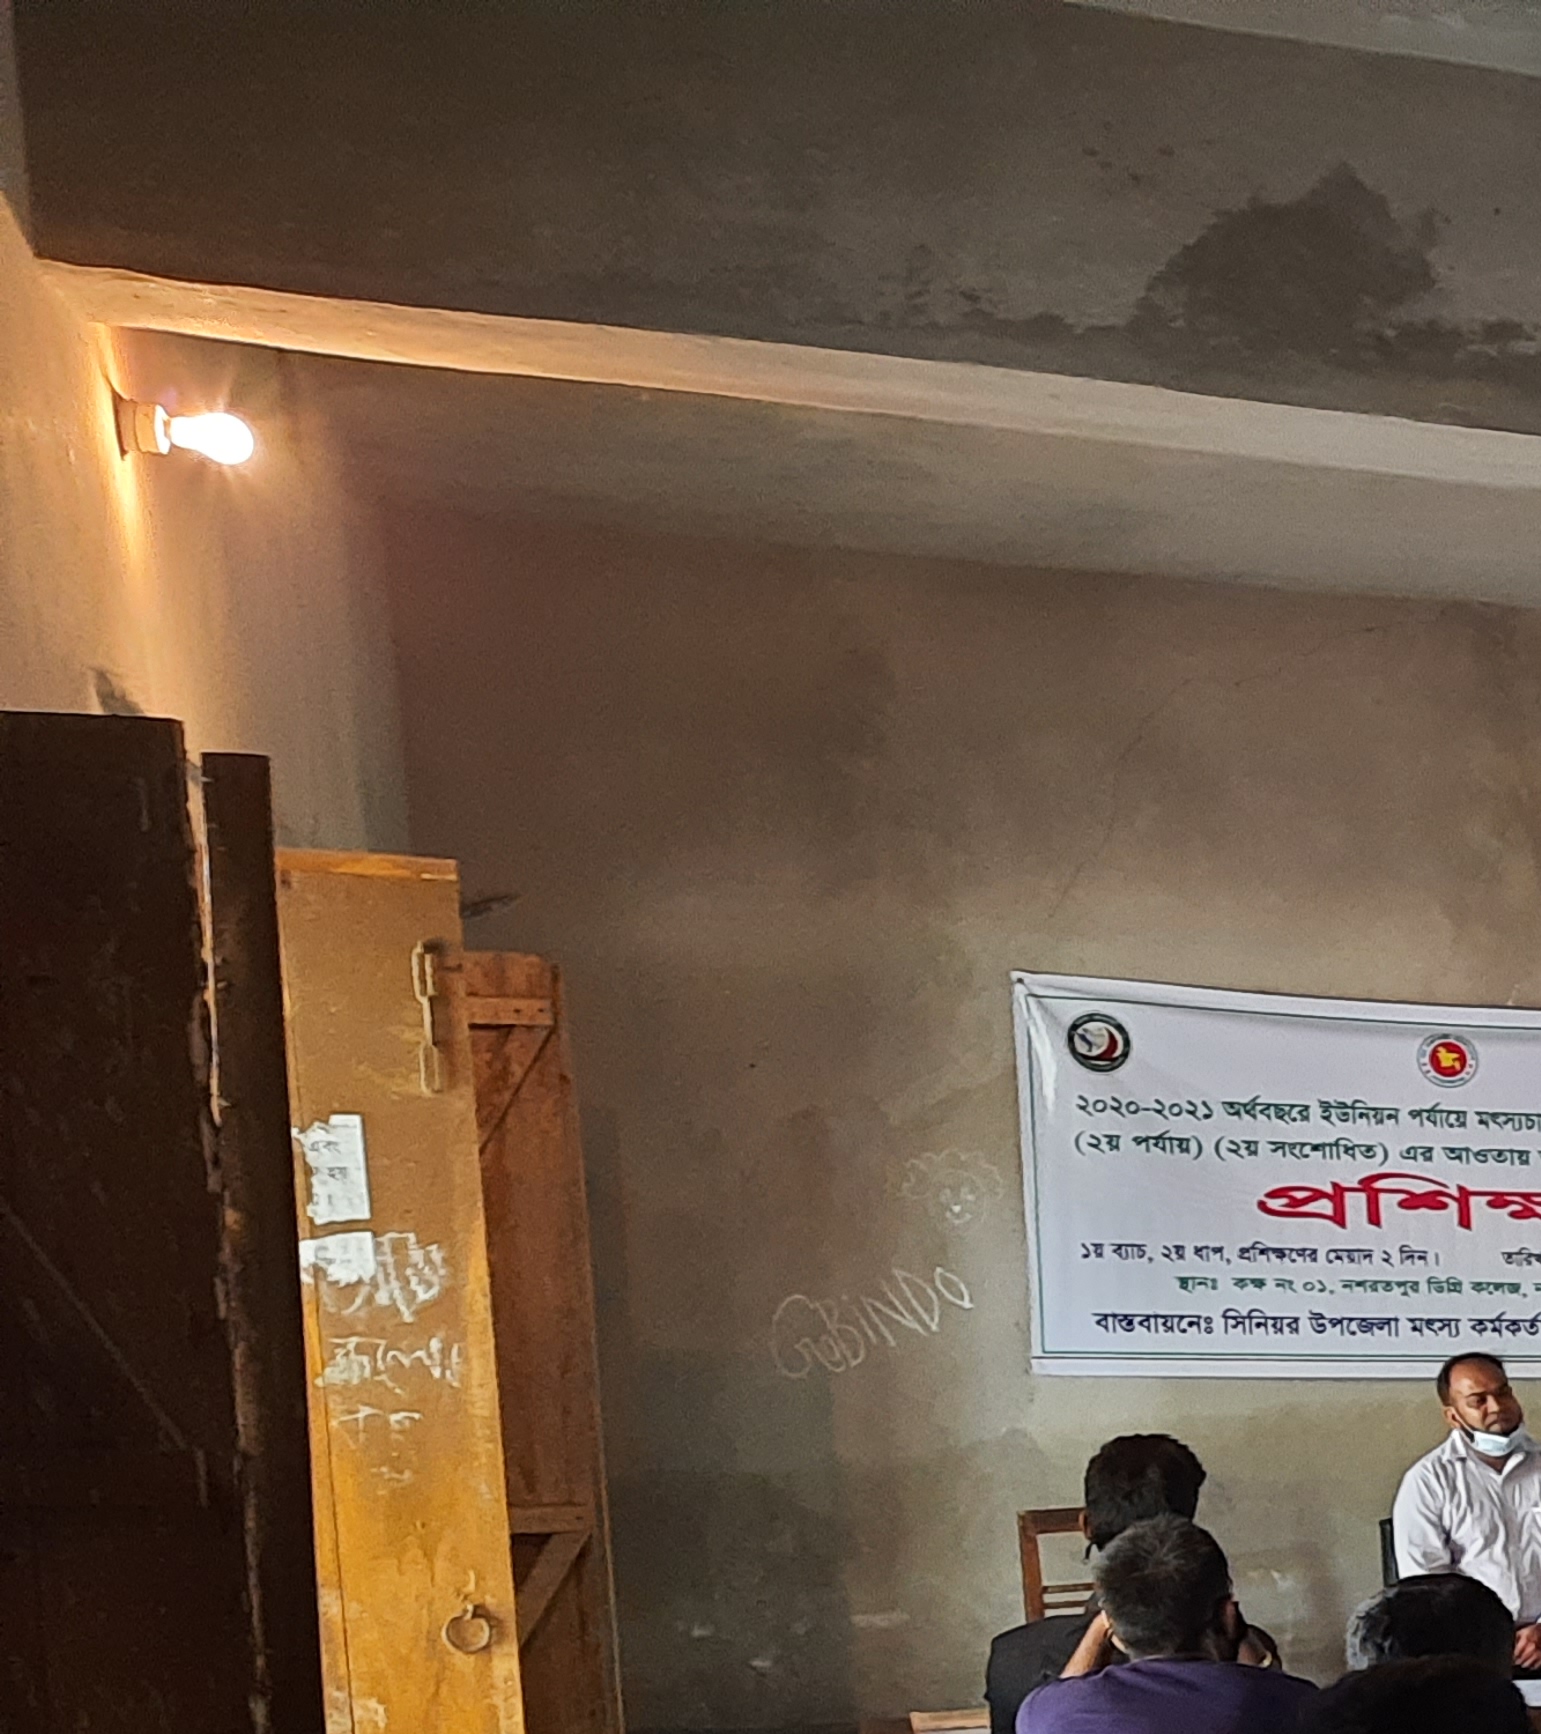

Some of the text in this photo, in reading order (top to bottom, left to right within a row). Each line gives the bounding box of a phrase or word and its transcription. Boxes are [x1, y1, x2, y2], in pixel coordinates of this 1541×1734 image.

[1075, 1095, 1214, 1120] ২০২০-২০২১
[1222, 1095, 1311, 1125] অর্থবছরে
[1319, 1099, 1400, 1126] ইউনিয়ন
[1408, 1102, 1467, 1130] পর্যায়ে
[1074, 1131, 1121, 1156] (২য়
[1131, 1130, 1203, 1161] পর্যায়)
[1214, 1136, 1259, 1162] (২য়
[1267, 1137, 1389, 1166] সংশোধিত)
[1400, 1146, 1434, 1162] এর
[1441, 1147, 1531, 1166] আওতায়
[1237, 1241, 1318, 1264] প্রশিক্ষণের
[1326, 1248, 1373, 1265] মেয়াদ
[1381, 1250, 1394, 1267] ২
[1273, 1278, 1298, 1293] নং
[1092, 1311, 1214, 1335] বাস্তবায়নেঃ
[1222, 1308, 1300, 1336] সিনিয়র
[1308, 1309, 1400, 1338] উপজেলা
[1405, 1317, 1462, 1339] মৎস্য
